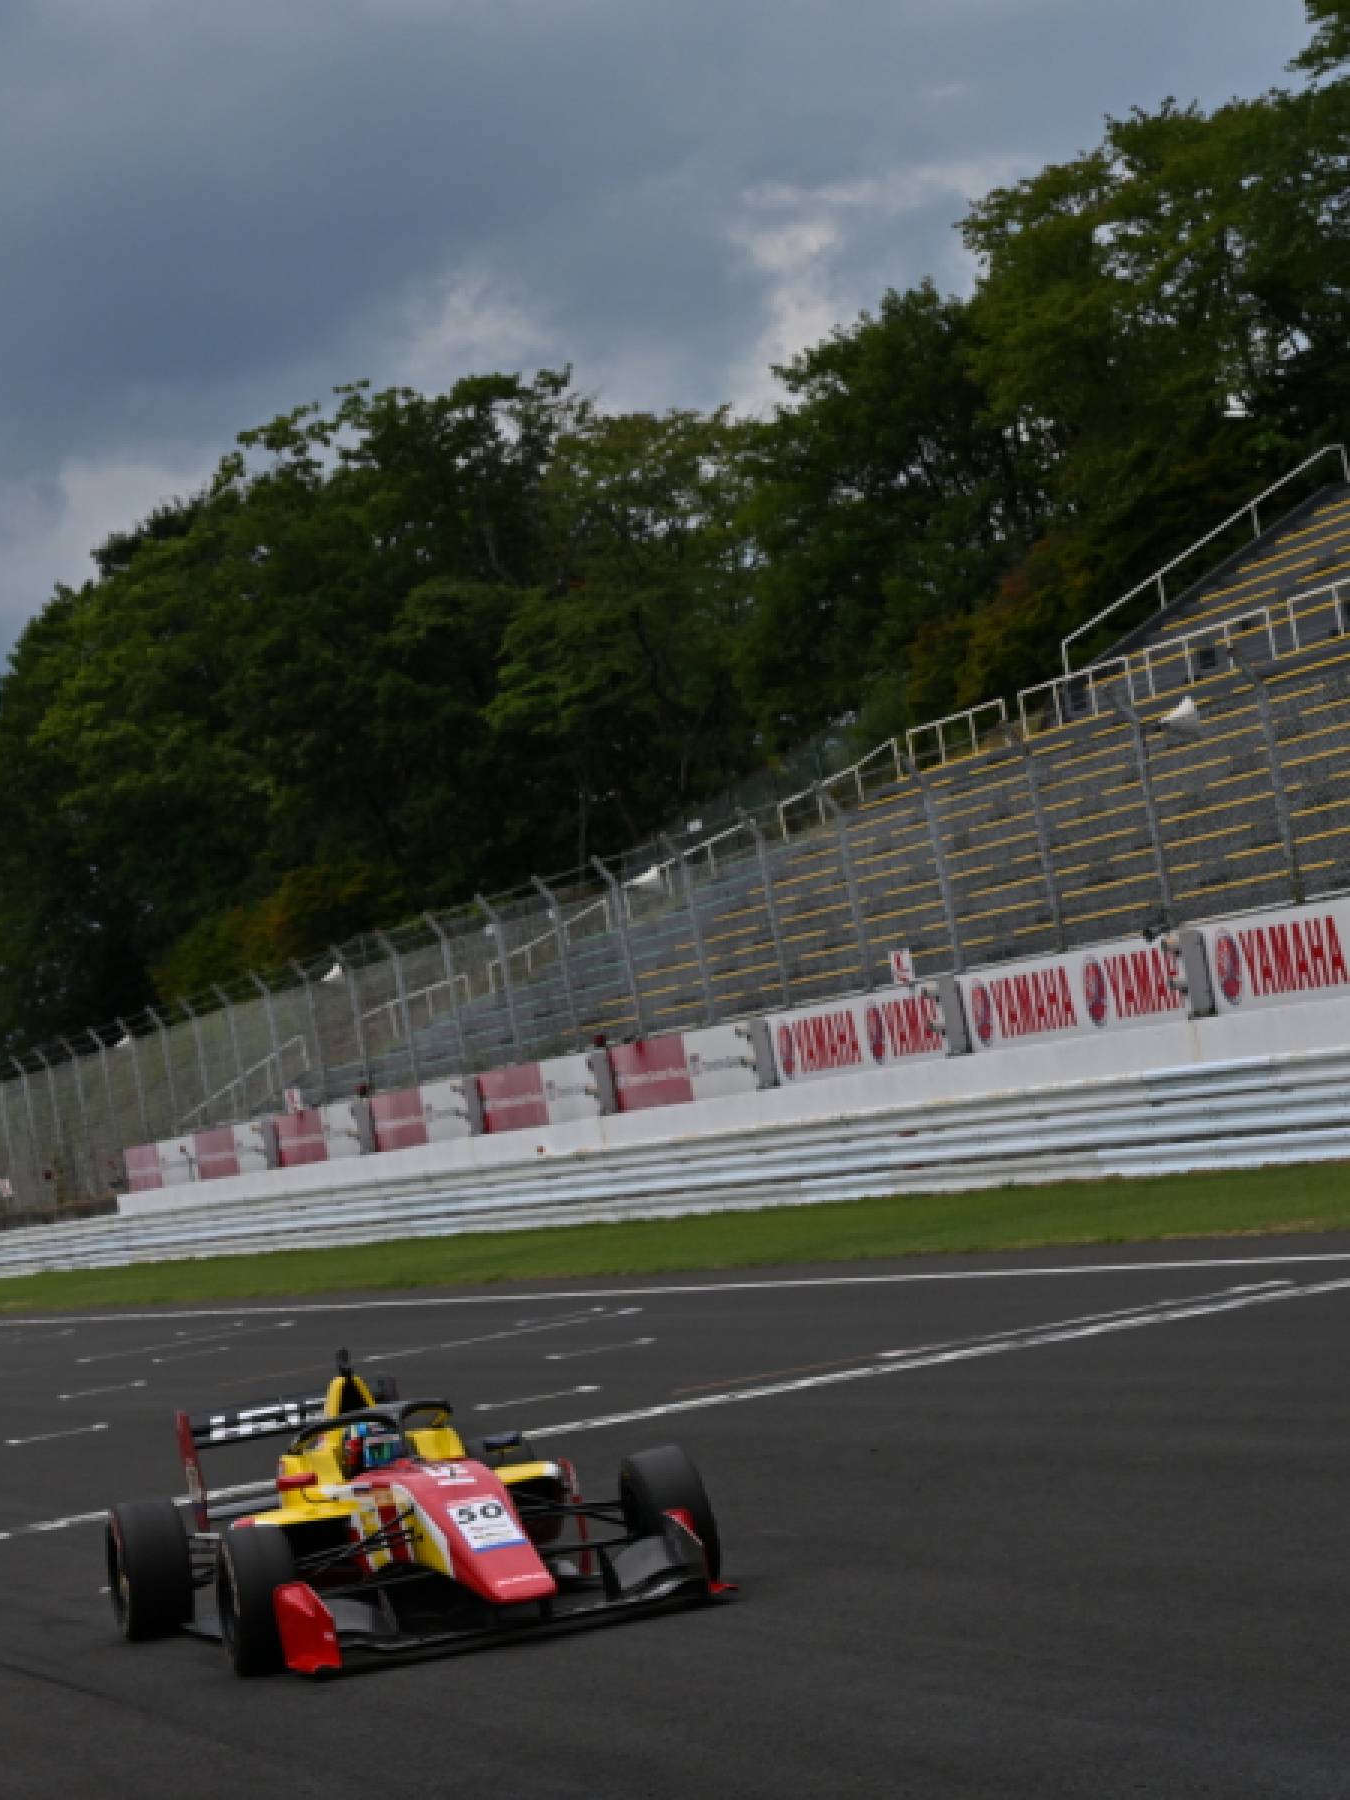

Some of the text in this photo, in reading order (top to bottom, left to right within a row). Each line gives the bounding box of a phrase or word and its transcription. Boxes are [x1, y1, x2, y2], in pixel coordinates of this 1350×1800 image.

[1103, 948, 1186, 1018] YAMAH
[1237, 915, 1350, 997] YAMAHA
[989, 966, 1078, 1039] YAMAHA
[792, 1009, 862, 1073] YAMAHA
[457, 1502, 503, 1525] 50
